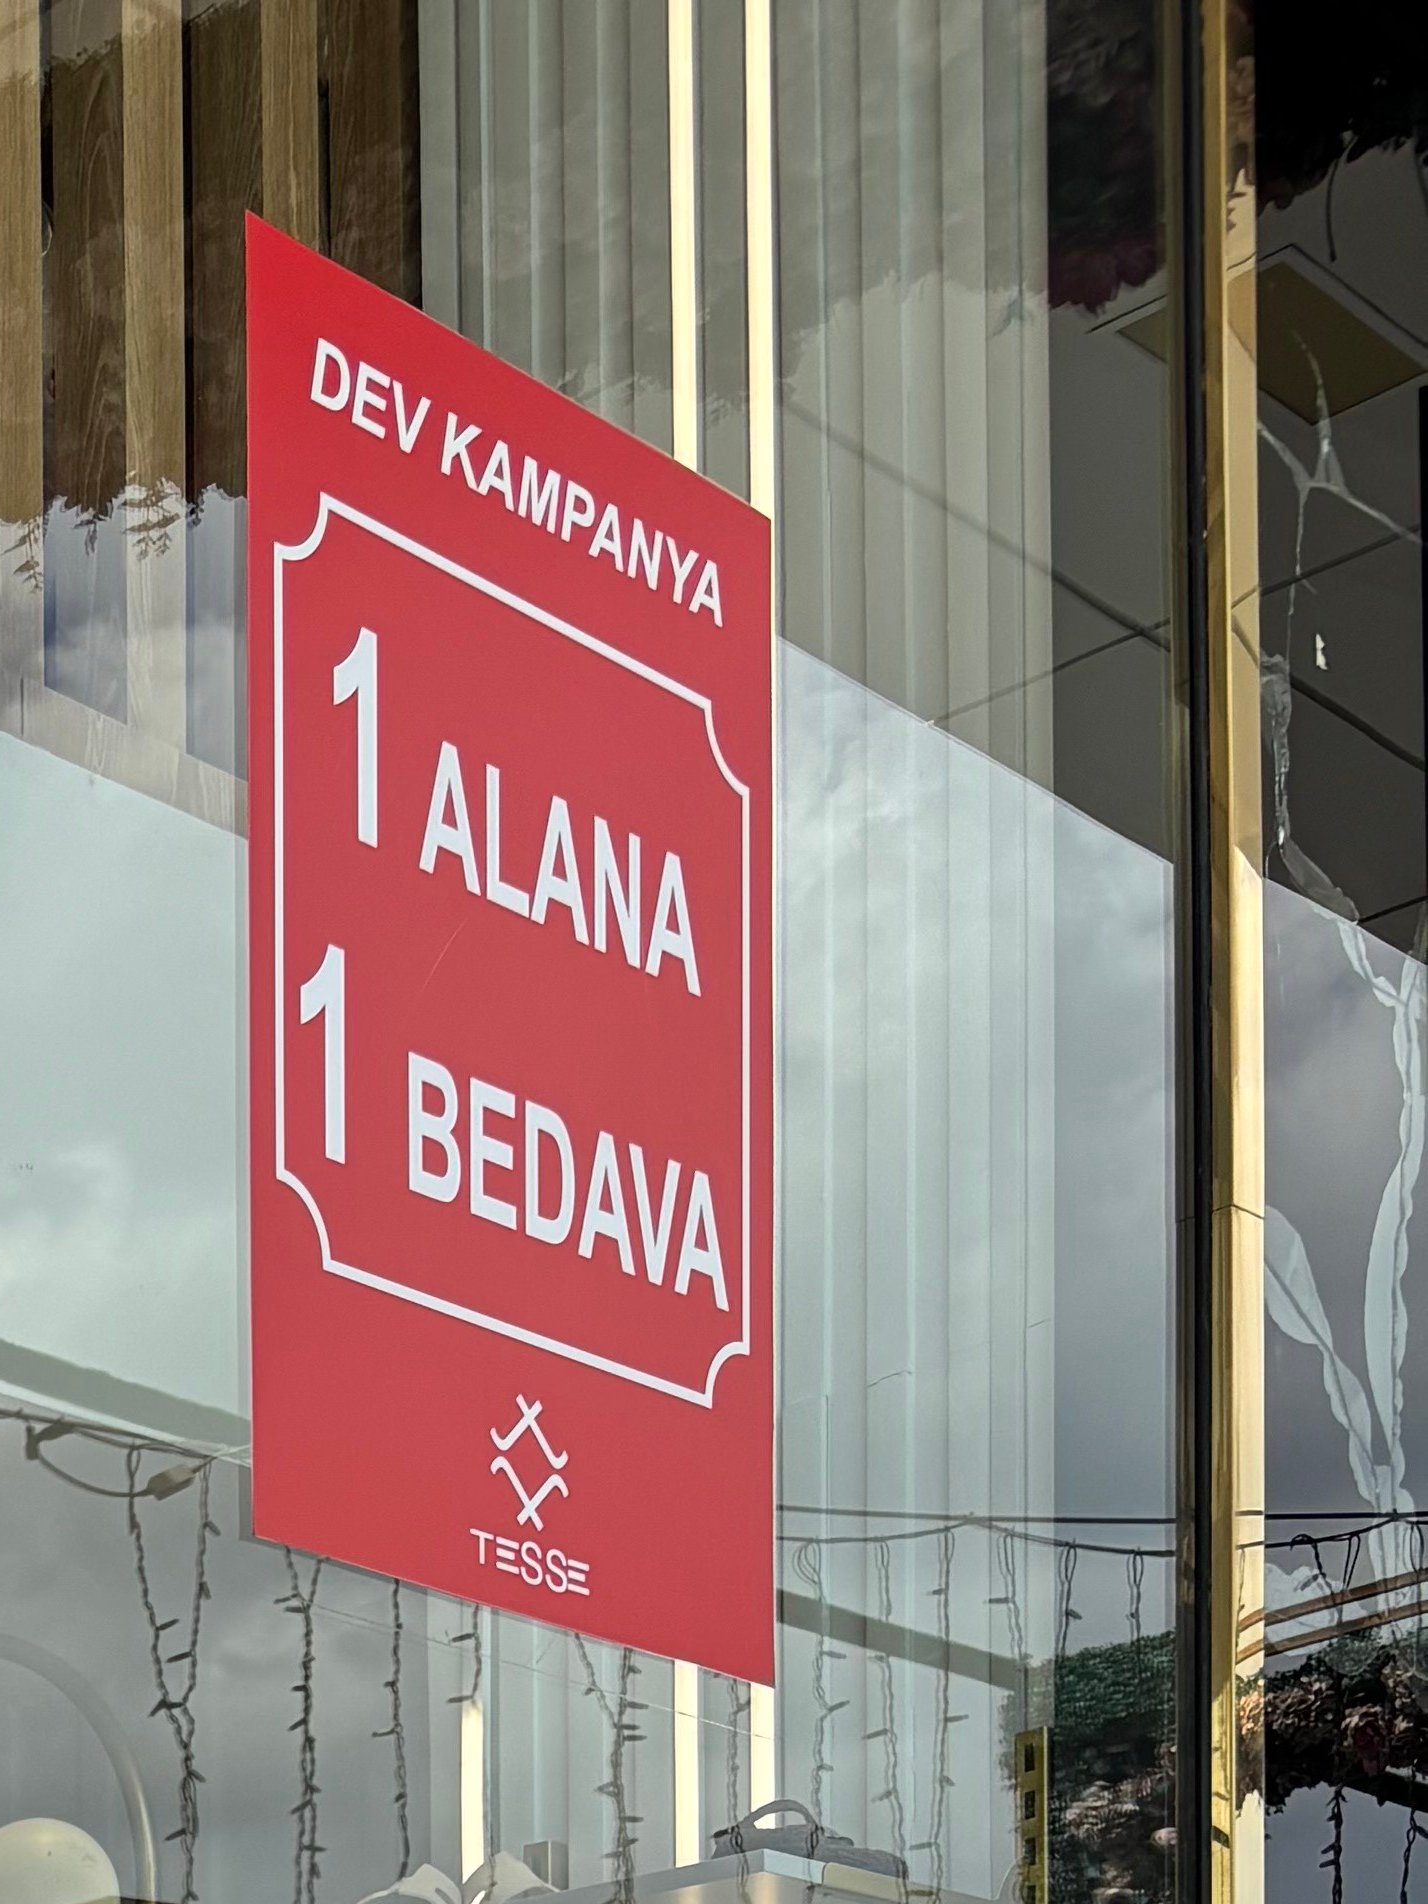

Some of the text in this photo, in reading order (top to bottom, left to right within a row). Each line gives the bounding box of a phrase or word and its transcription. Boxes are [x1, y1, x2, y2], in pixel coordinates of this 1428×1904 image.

[310, 337, 724, 629] DEV KAMPANYA
[333, 626, 702, 998] 1 ALANA
[300, 943, 730, 1313] 1 BEDAVA
[469, 1528, 590, 1597] TESSE
